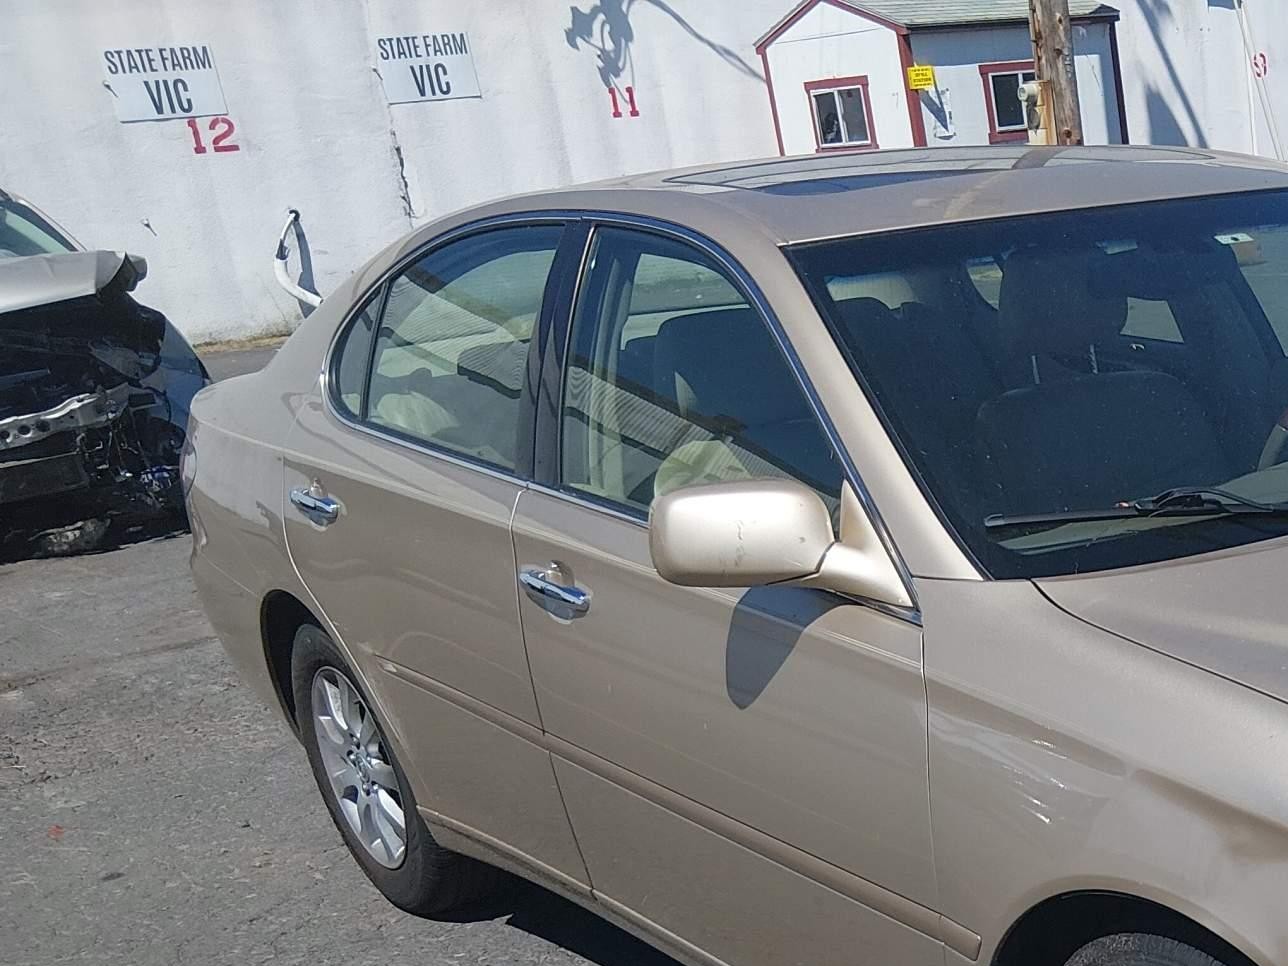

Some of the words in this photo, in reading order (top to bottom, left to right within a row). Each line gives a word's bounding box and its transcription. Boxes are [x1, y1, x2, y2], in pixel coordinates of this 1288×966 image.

[103, 48, 158, 75] STATE
[158, 45, 212, 72] FARM
[377, 36, 422, 60] STATE
[422, 32, 468, 57] FARM
[409, 62, 452, 97] VIC
[143, 78, 193, 115] VIC
[608, 86, 640, 118] 11
[187, 117, 240, 154] 12
